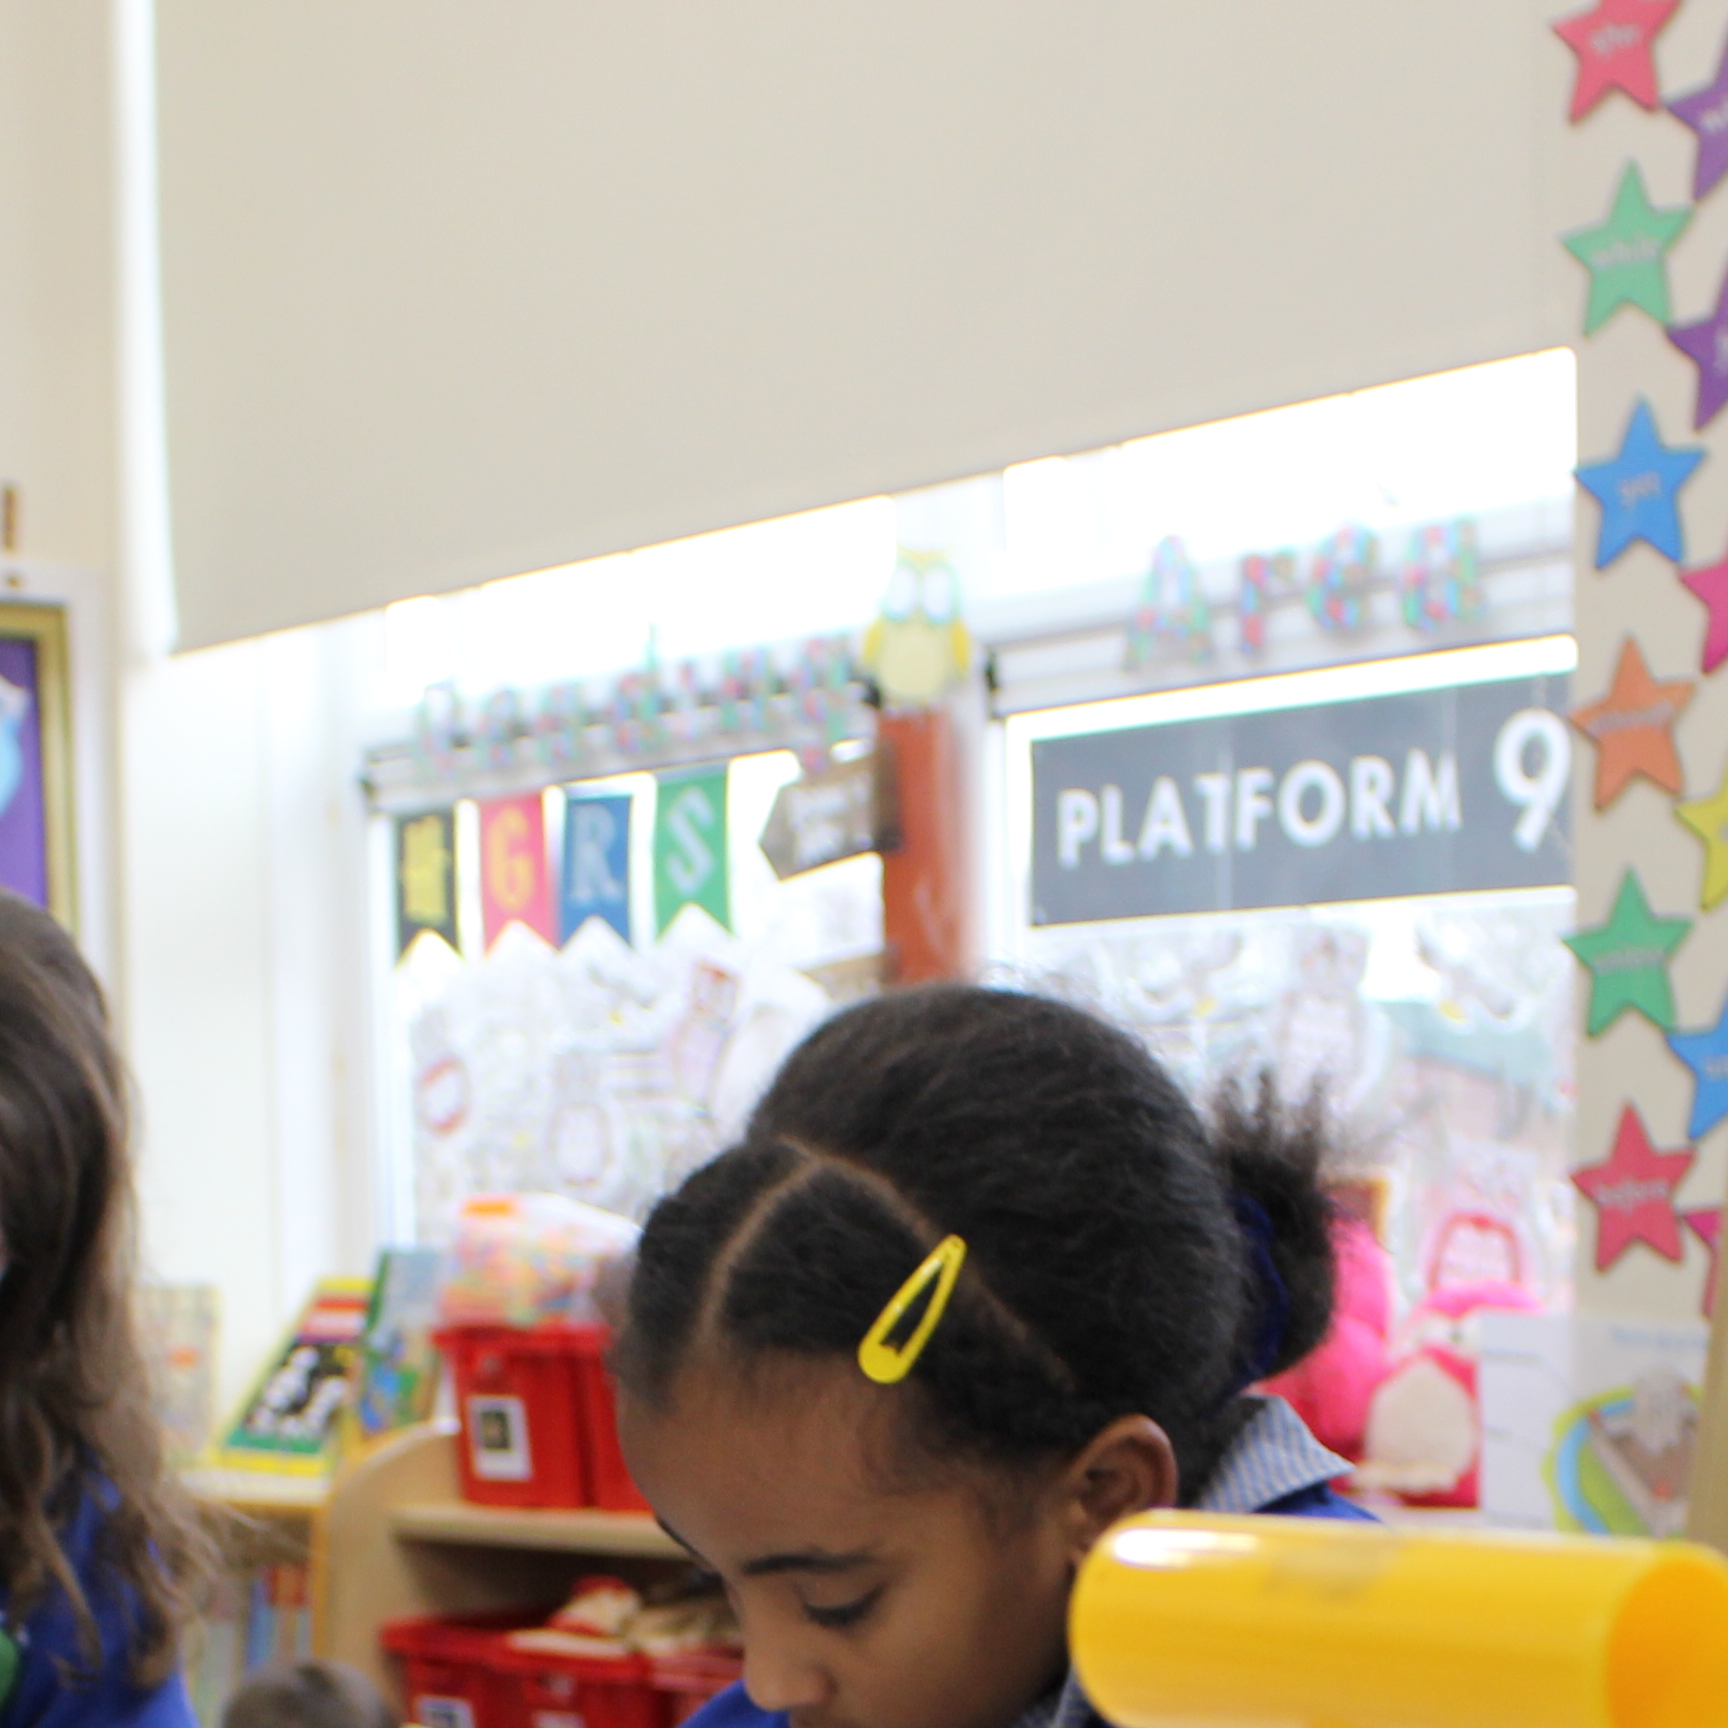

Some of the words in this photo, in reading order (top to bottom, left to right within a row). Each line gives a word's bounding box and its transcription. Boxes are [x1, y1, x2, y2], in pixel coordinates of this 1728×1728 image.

[1120, 516, 1487, 673] Area
[1057, 747, 1464, 870] PLATFORM
[1492, 706, 1571, 852] 9
